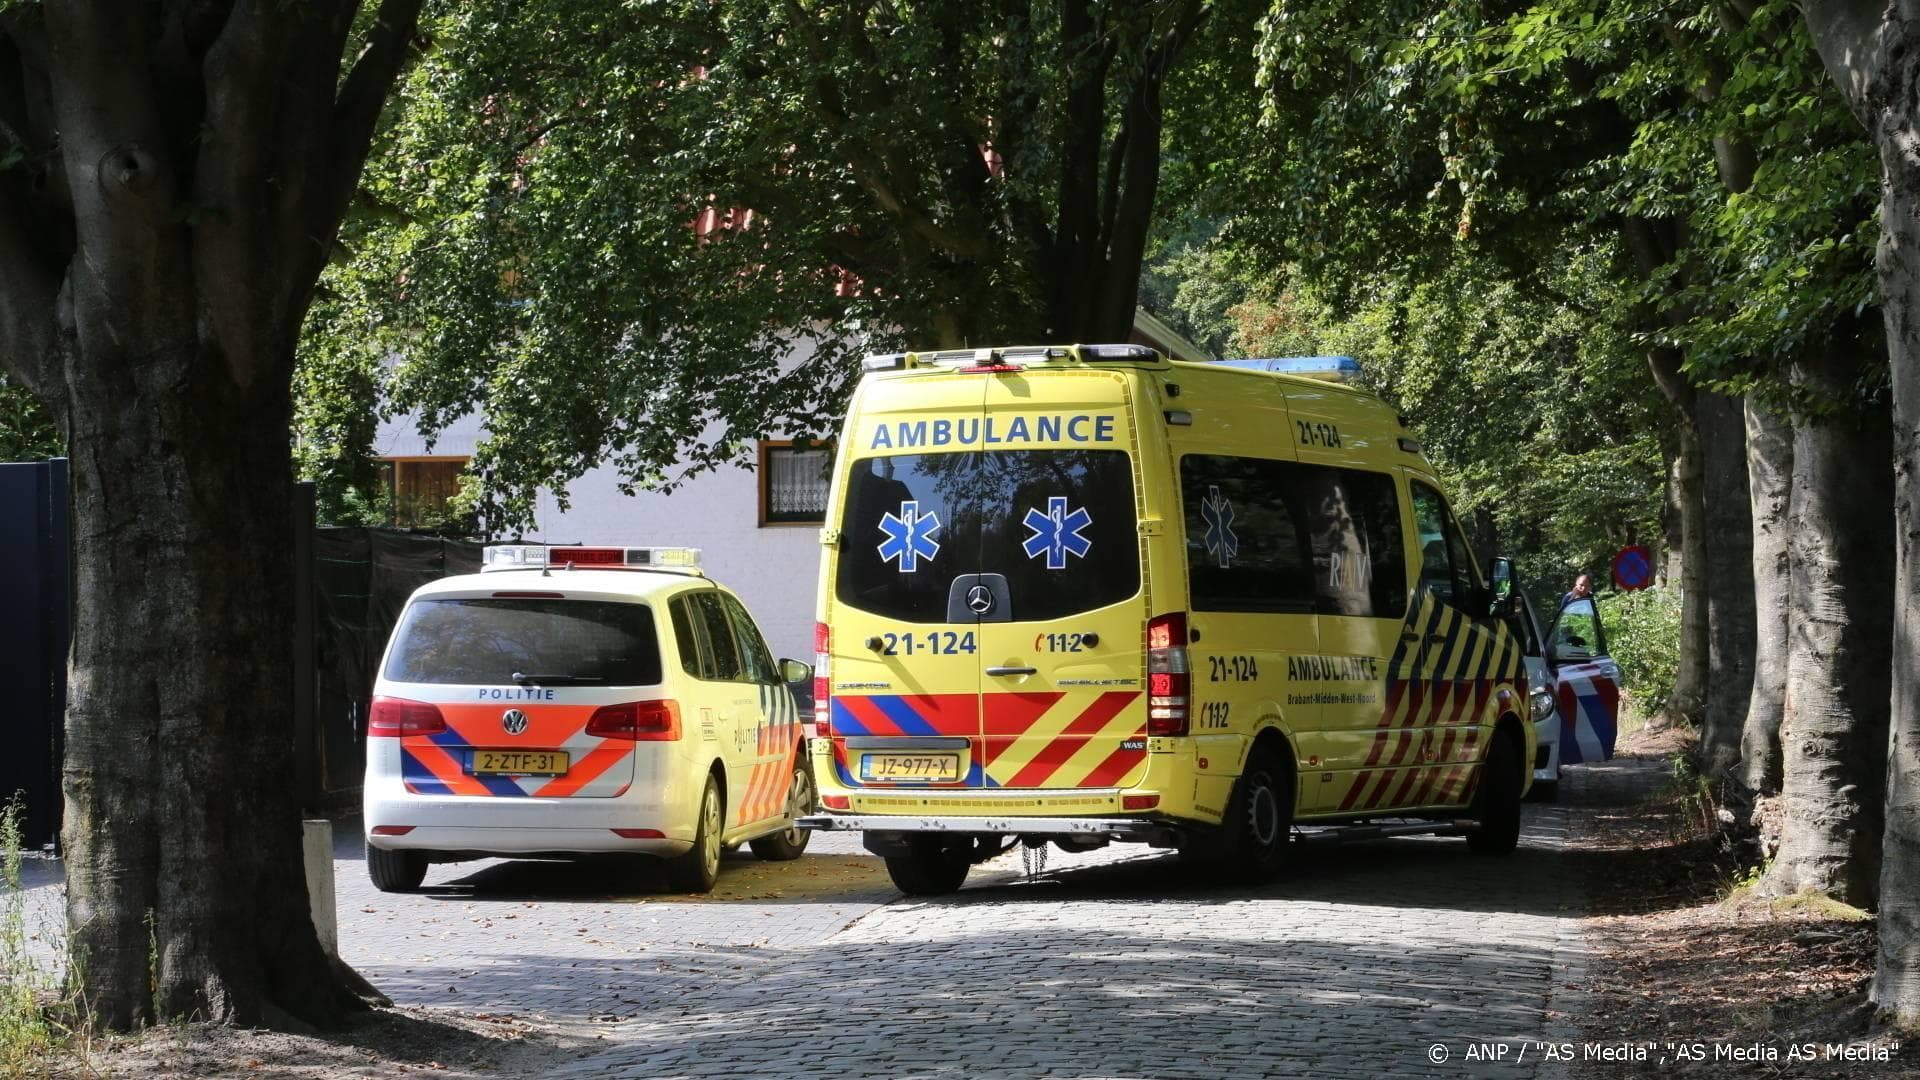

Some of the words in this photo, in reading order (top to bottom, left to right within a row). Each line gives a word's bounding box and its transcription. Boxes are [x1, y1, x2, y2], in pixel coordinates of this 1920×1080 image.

[871, 415, 1115, 450] AMBULANCE
[1297, 420, 1342, 449] 21-124
[883, 631, 977, 656] 21-124
[1208, 655, 1258, 682] 21-124
[1287, 655, 1378, 681] AMBULANCE
[479, 688, 554, 700] POLITIE
[483, 753, 555, 770] 2-ZTF-31
[878, 758, 949, 775] JZ-977-X
